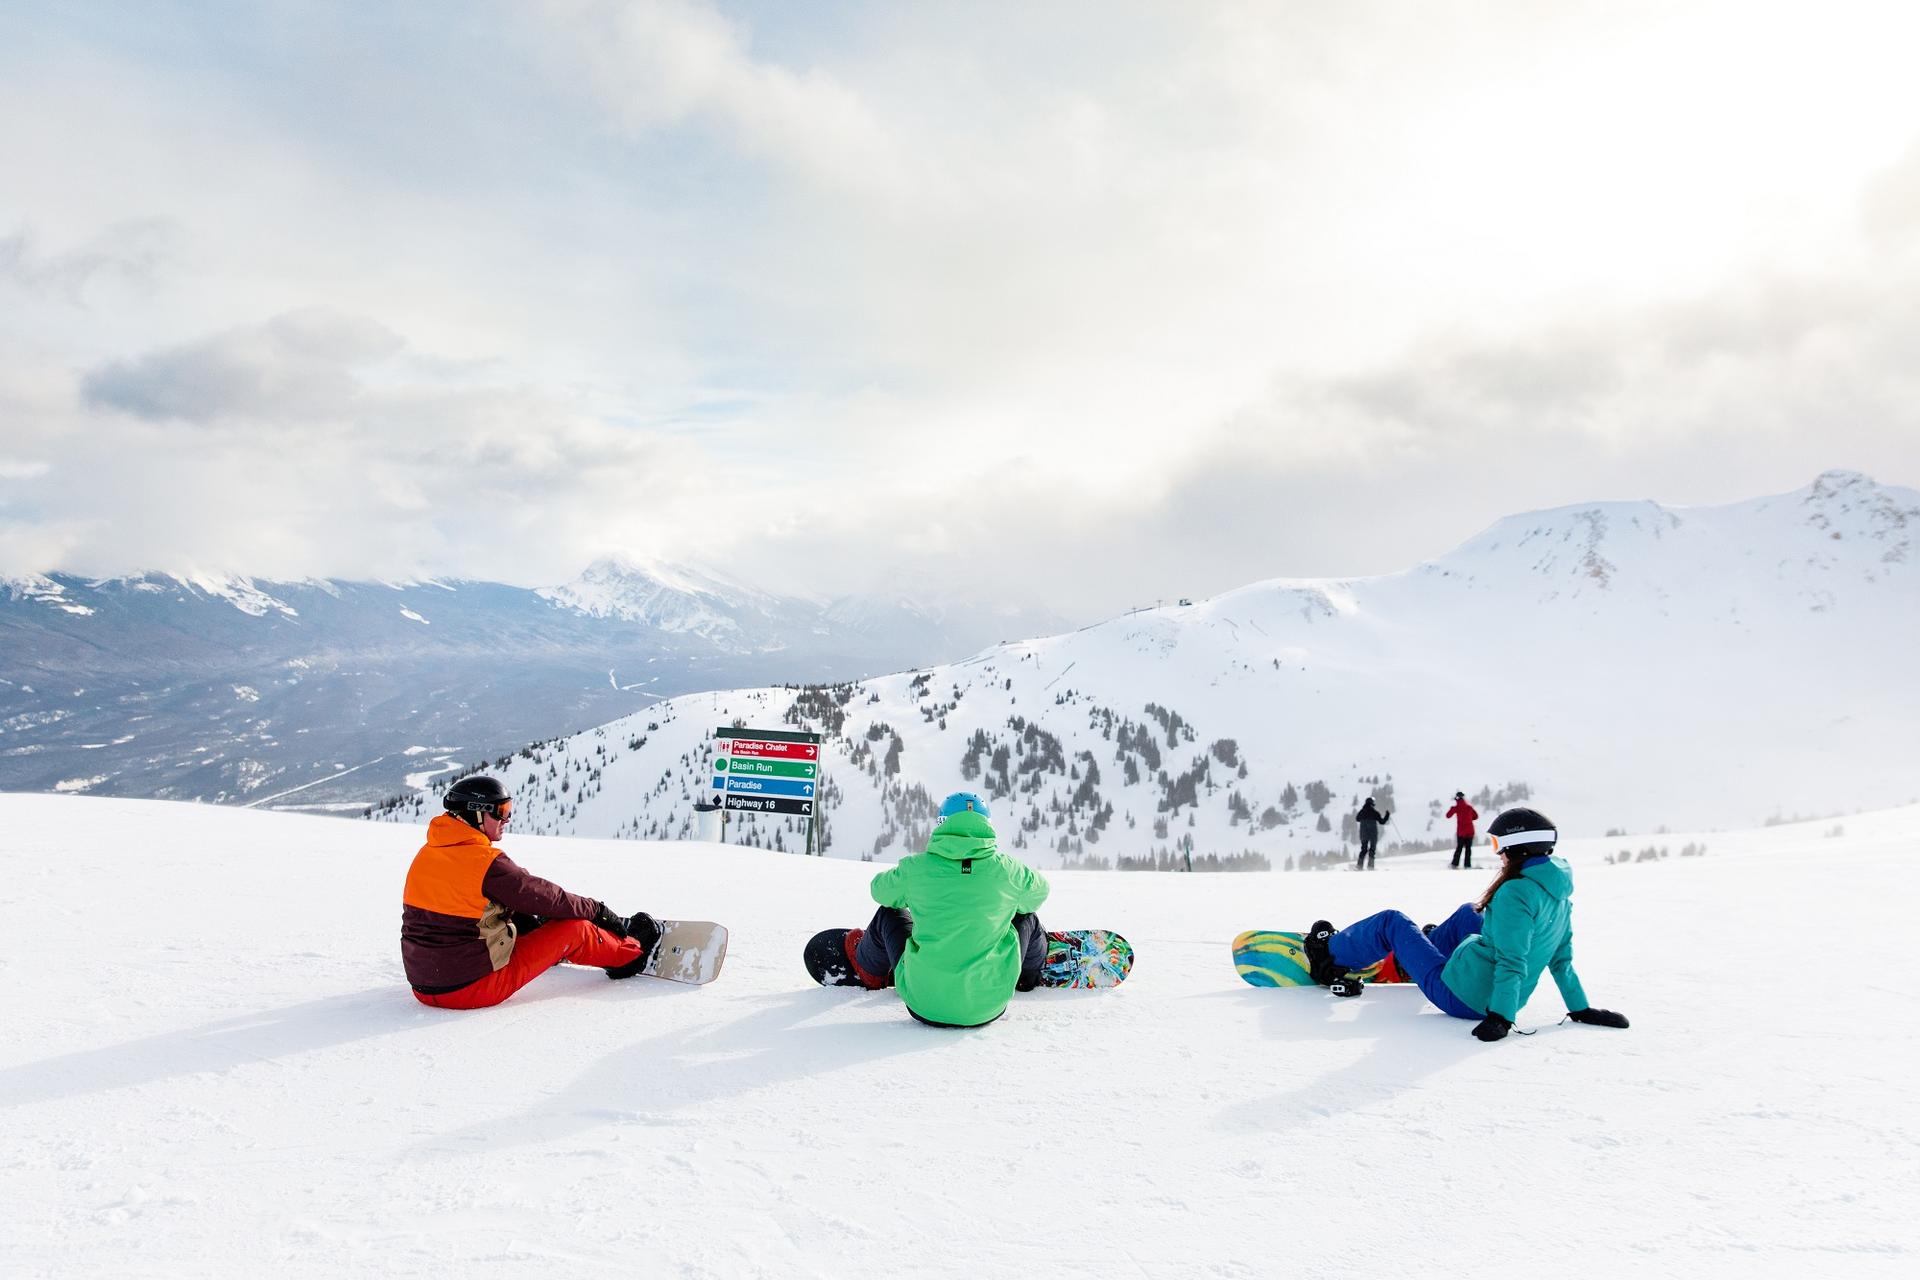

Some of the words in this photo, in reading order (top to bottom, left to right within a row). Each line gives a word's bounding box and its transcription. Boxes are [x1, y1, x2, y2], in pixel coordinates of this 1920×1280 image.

[734, 741, 763, 750] Paradise
[765, 743, 787, 752] Chalet
[732, 761, 754, 771] Basin
[756, 763, 773, 772] Run
[728, 780, 762, 789] Paradise
[727, 797, 763, 810] Highway
[765, 800, 775, 809] 16
